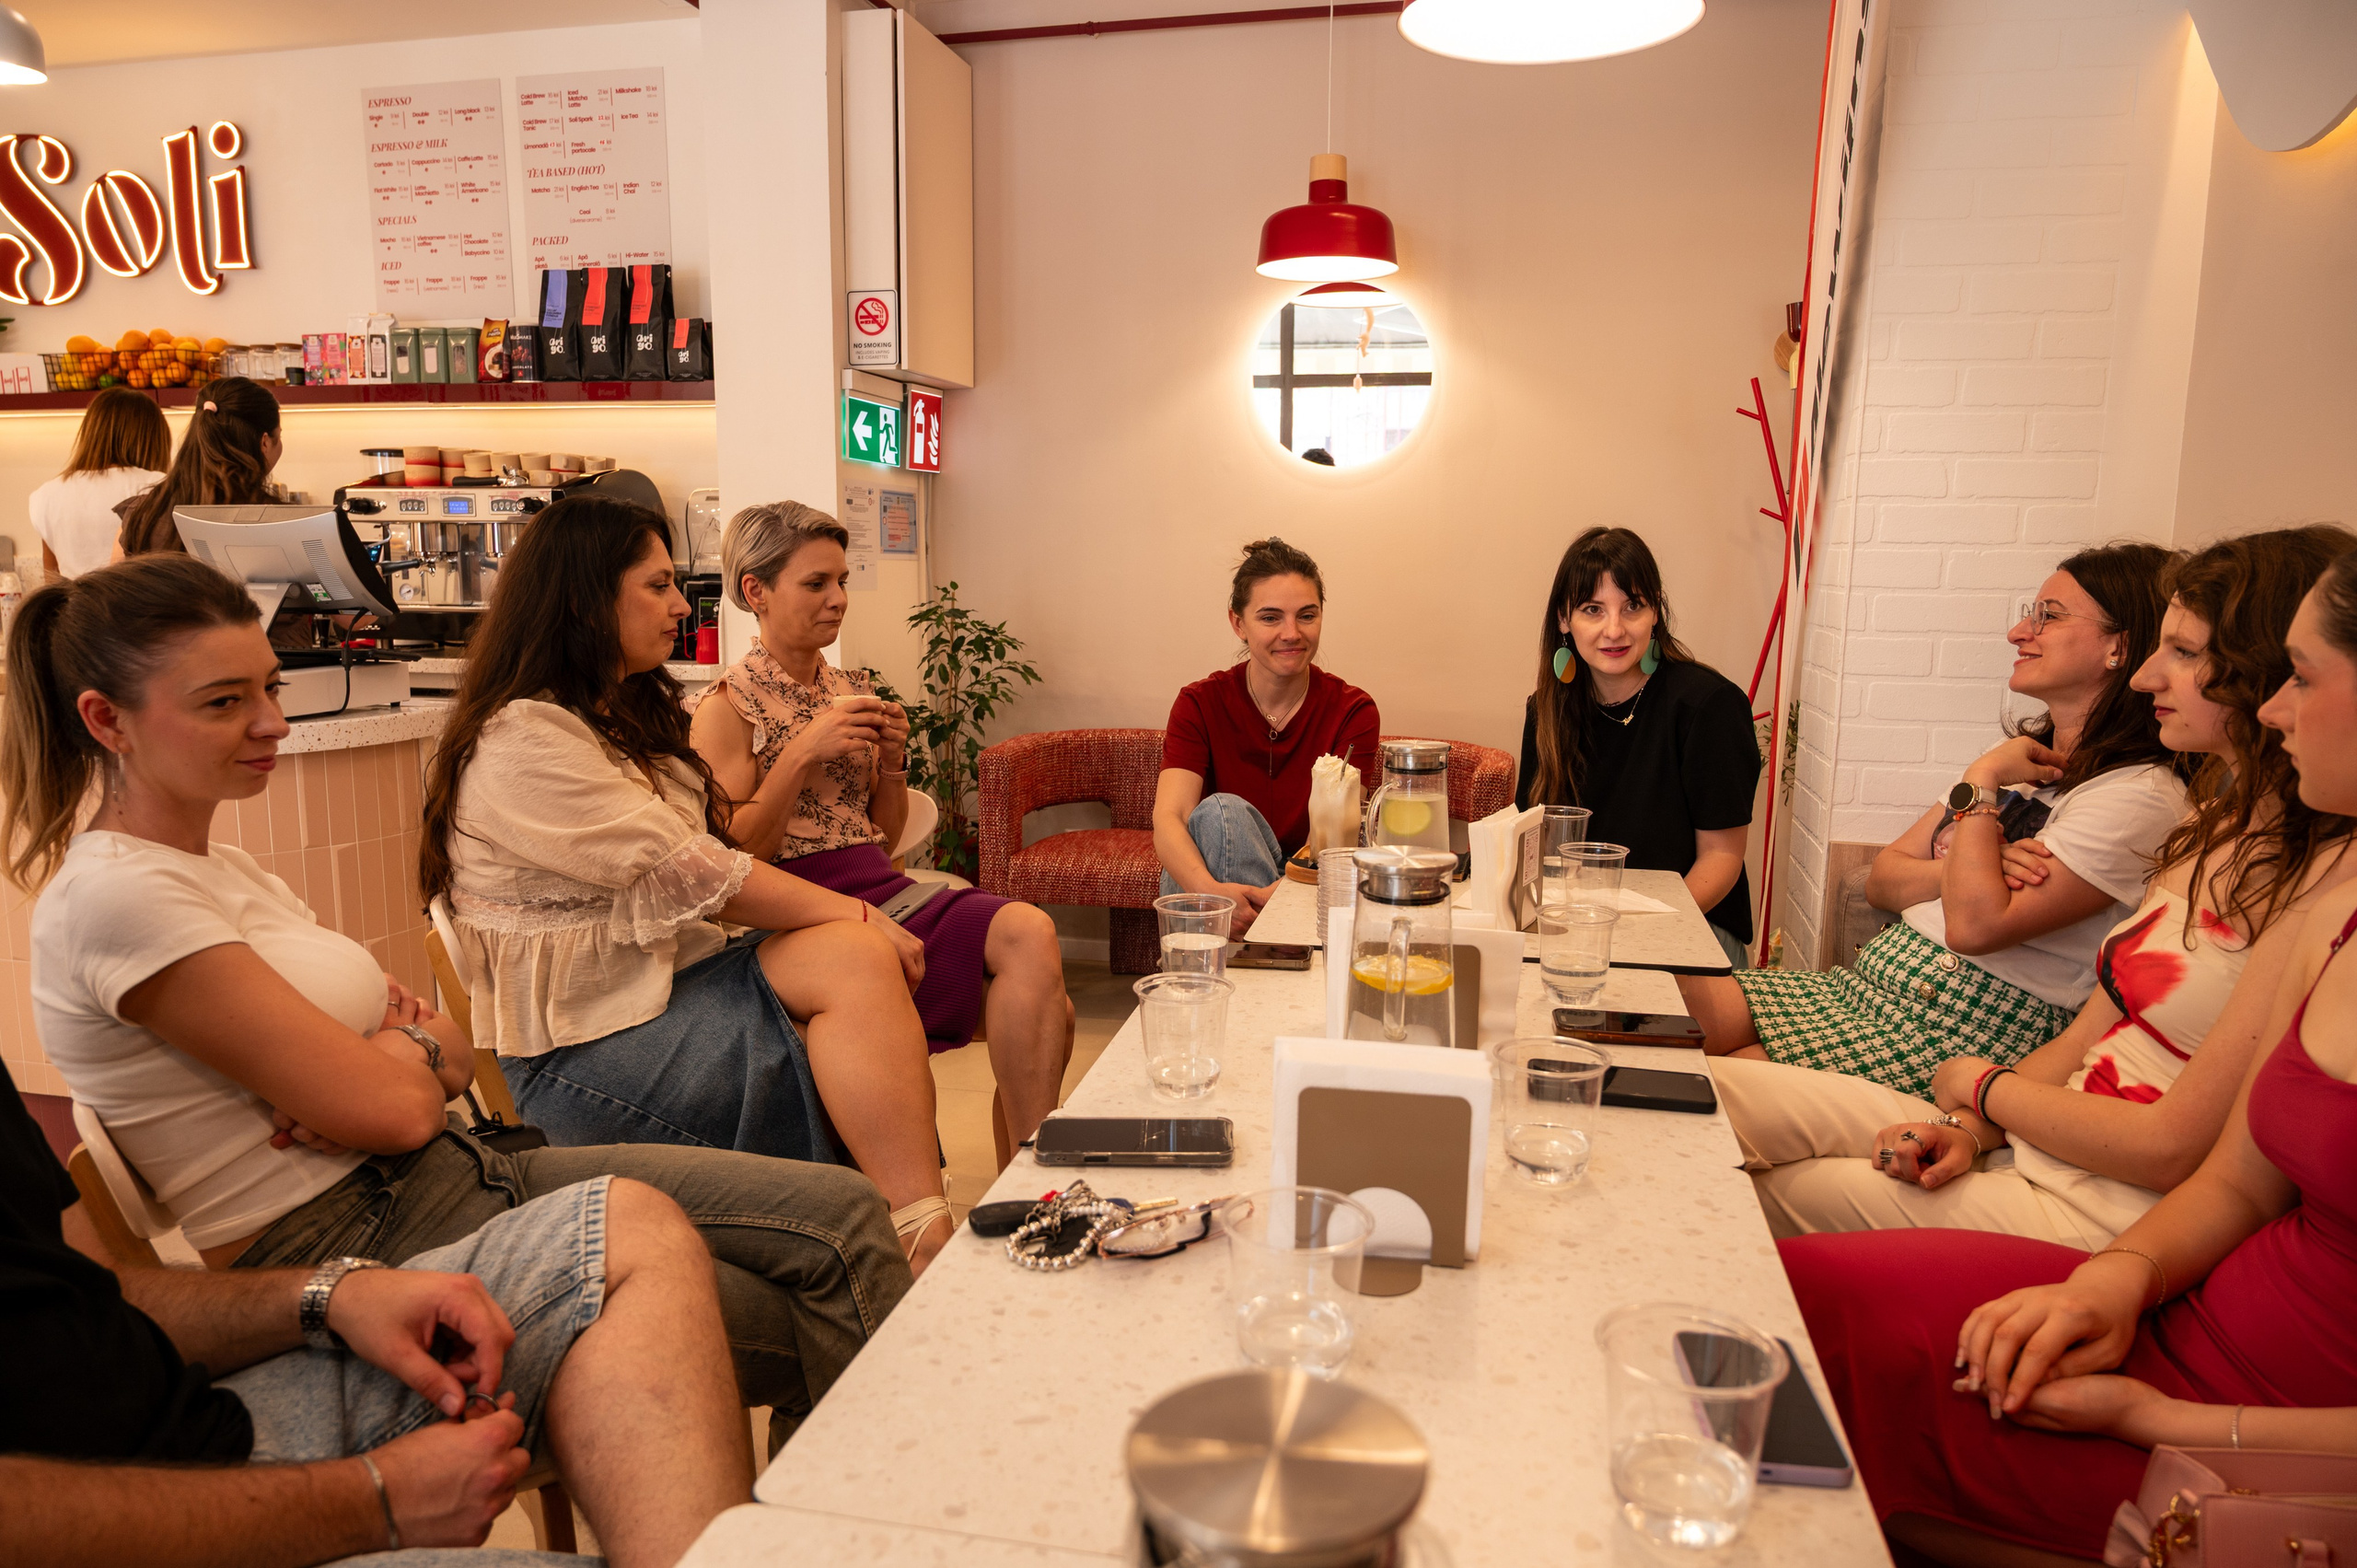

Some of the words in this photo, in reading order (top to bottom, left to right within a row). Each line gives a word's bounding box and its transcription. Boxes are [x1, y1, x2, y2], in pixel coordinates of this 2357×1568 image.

[368, 97, 412, 109] ESPRESSO
[578, 115, 594, 123] Spark
[371, 141, 414, 153] ESPRESSO
[415, 140, 424, 150] &
[424, 138, 448, 149] MILK
[527, 168, 544, 179] TEA
[546, 166, 576, 178] BASED
[577, 163, 606, 177] (HOT)
[0, 121, 257, 306] Soli
[377, 215, 417, 226] SPECIALS
[532, 236, 569, 246] PACKED
[381, 261, 401, 271] ICED
